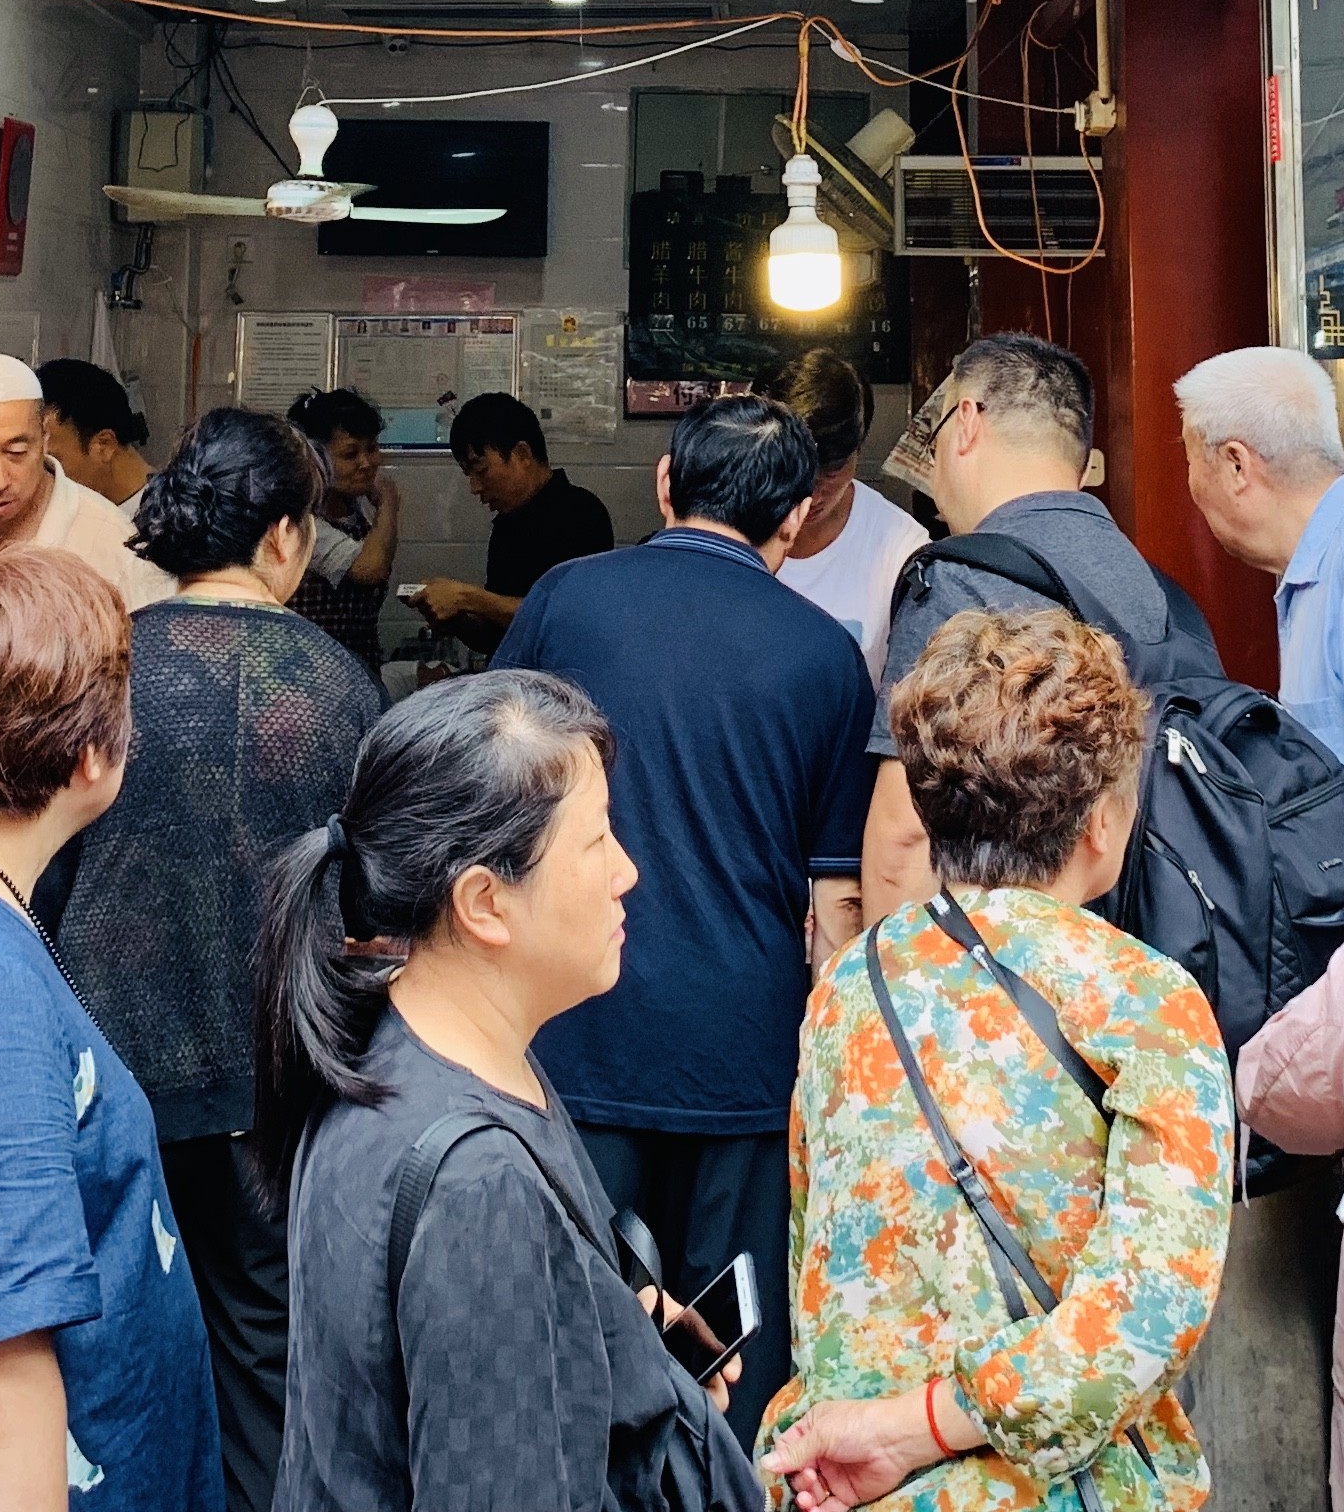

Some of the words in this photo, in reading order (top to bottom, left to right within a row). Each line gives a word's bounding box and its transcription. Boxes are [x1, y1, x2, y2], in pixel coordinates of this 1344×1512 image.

[687, 316, 708, 329] 65
[724, 317, 745, 331] 67
[870, 320, 891, 333] 16
